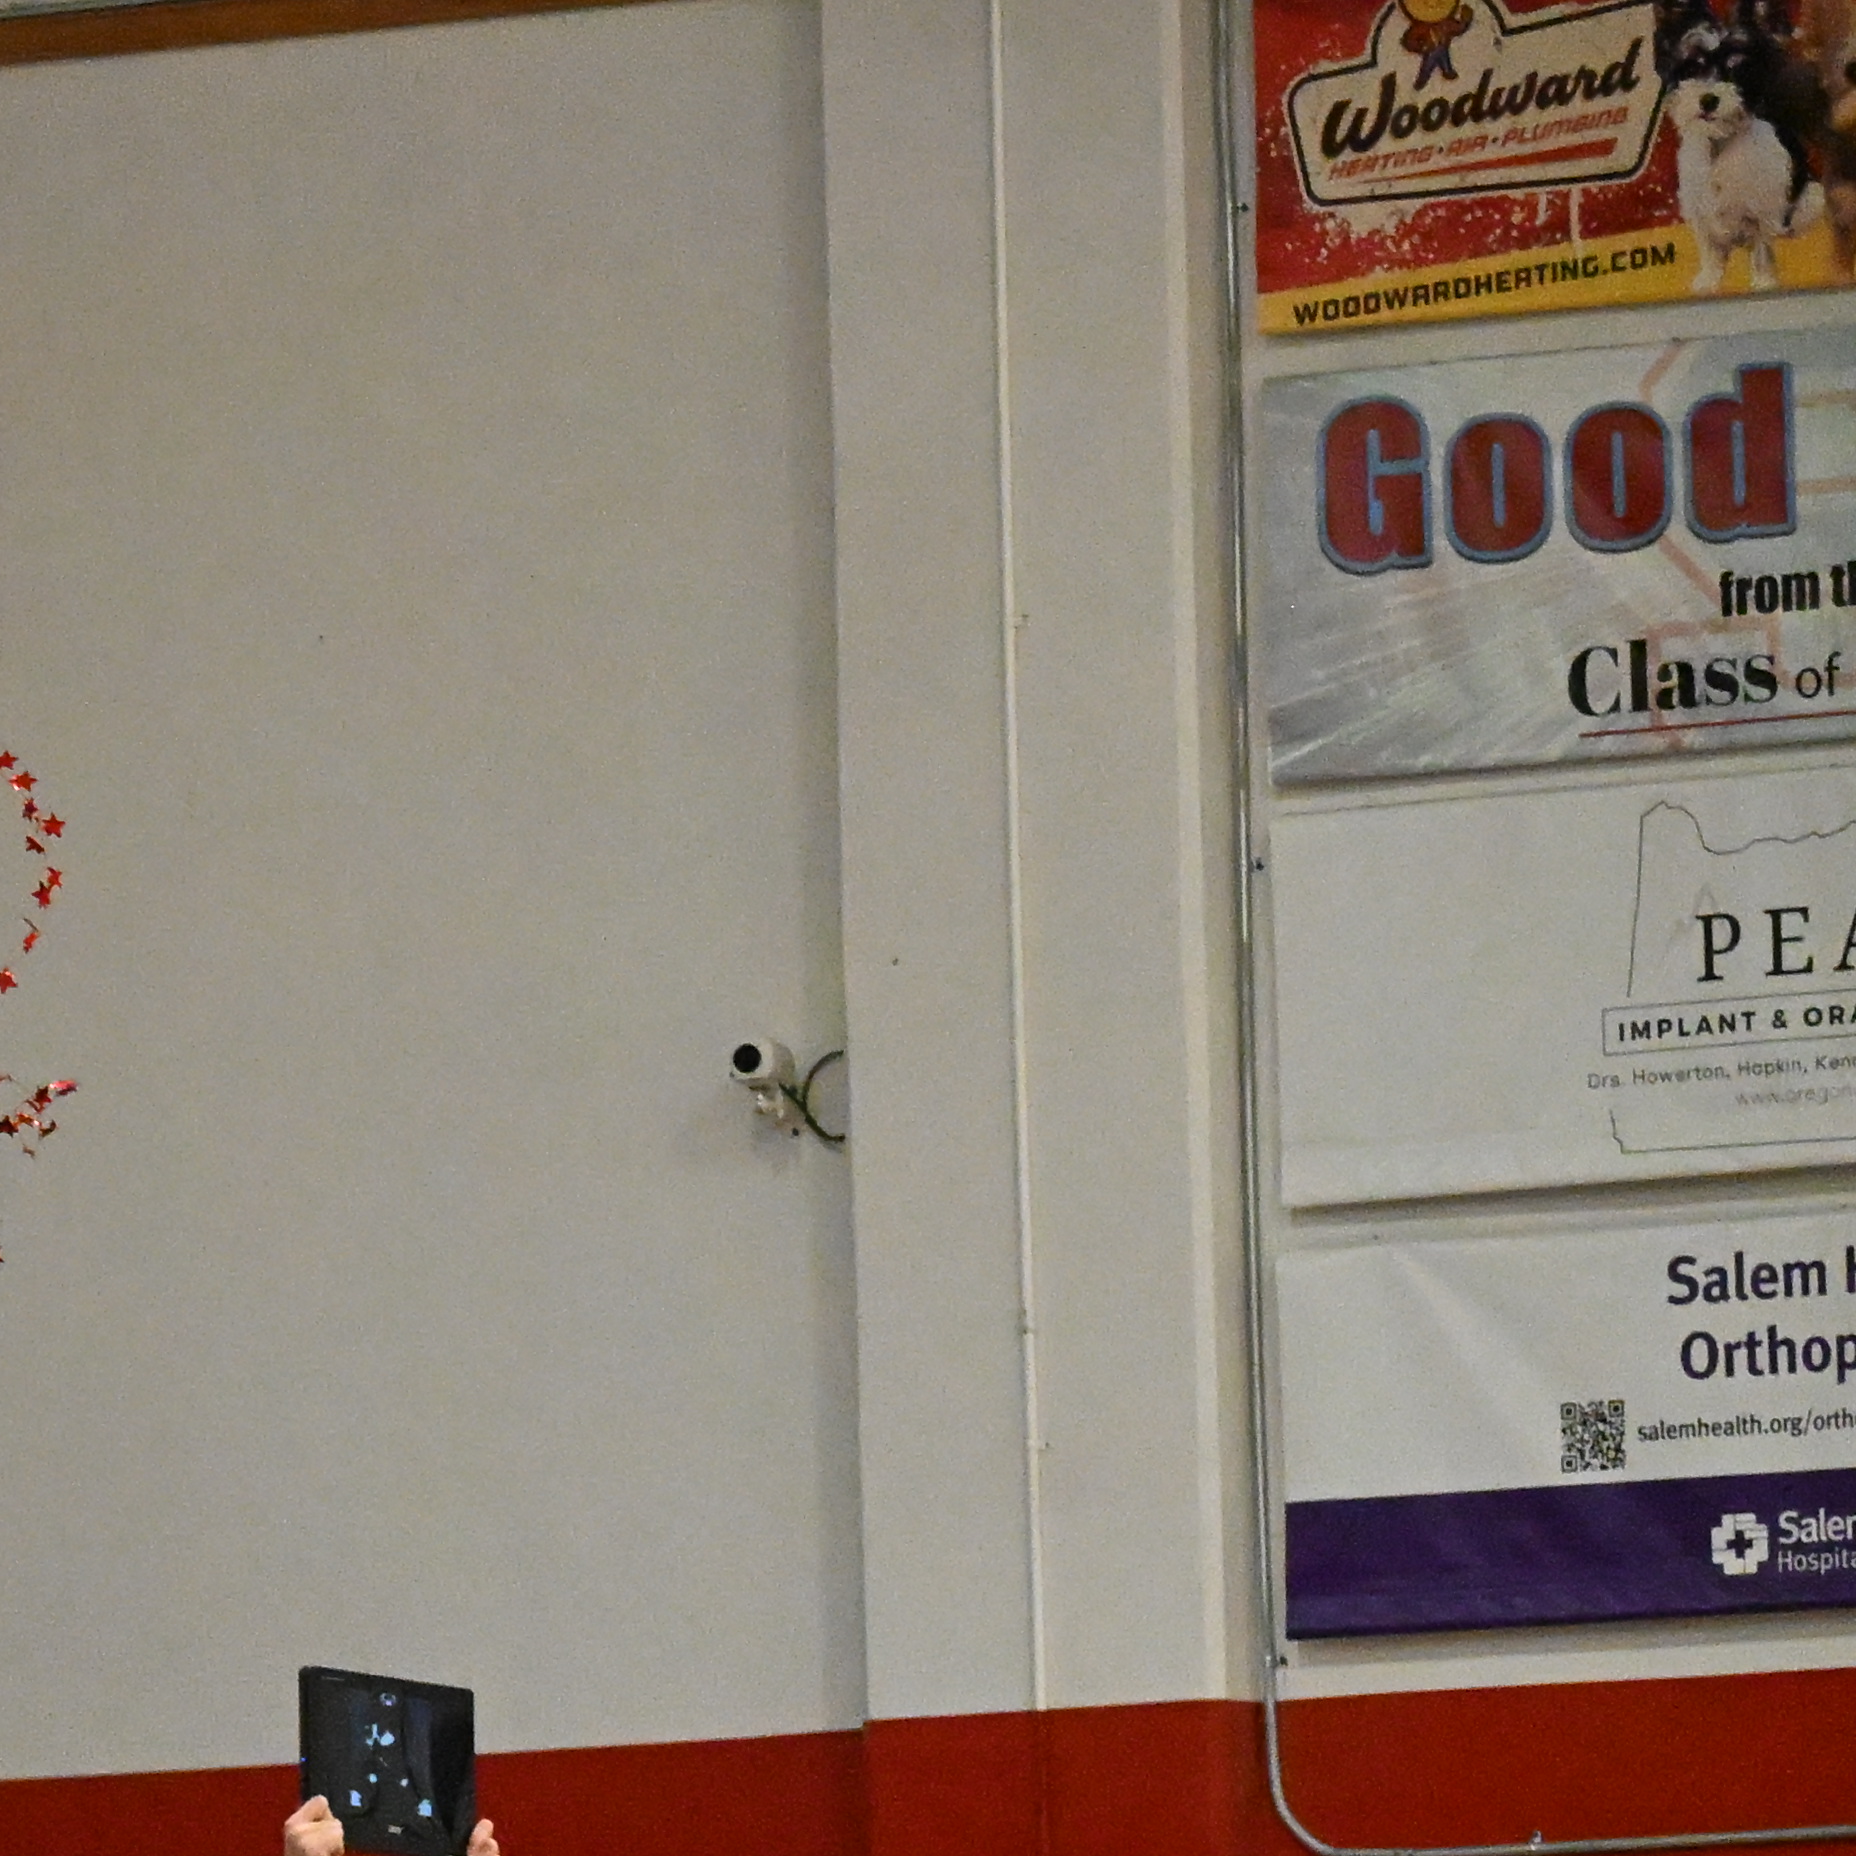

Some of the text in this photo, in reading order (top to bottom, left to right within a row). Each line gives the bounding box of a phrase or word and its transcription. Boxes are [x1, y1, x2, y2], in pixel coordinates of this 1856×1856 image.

[1320, 36, 1644, 160] Woodward
[1292, 242, 1677, 327] WOODWARDHEATING.COM
[1316, 362, 1799, 576] Good
[1719, 570, 1821, 618] from
[1567, 638, 1842, 719] Class of
[1618, 1004, 1856, 1043] IMPLANT & OR
[1666, 1250, 1828, 1306] Salem
